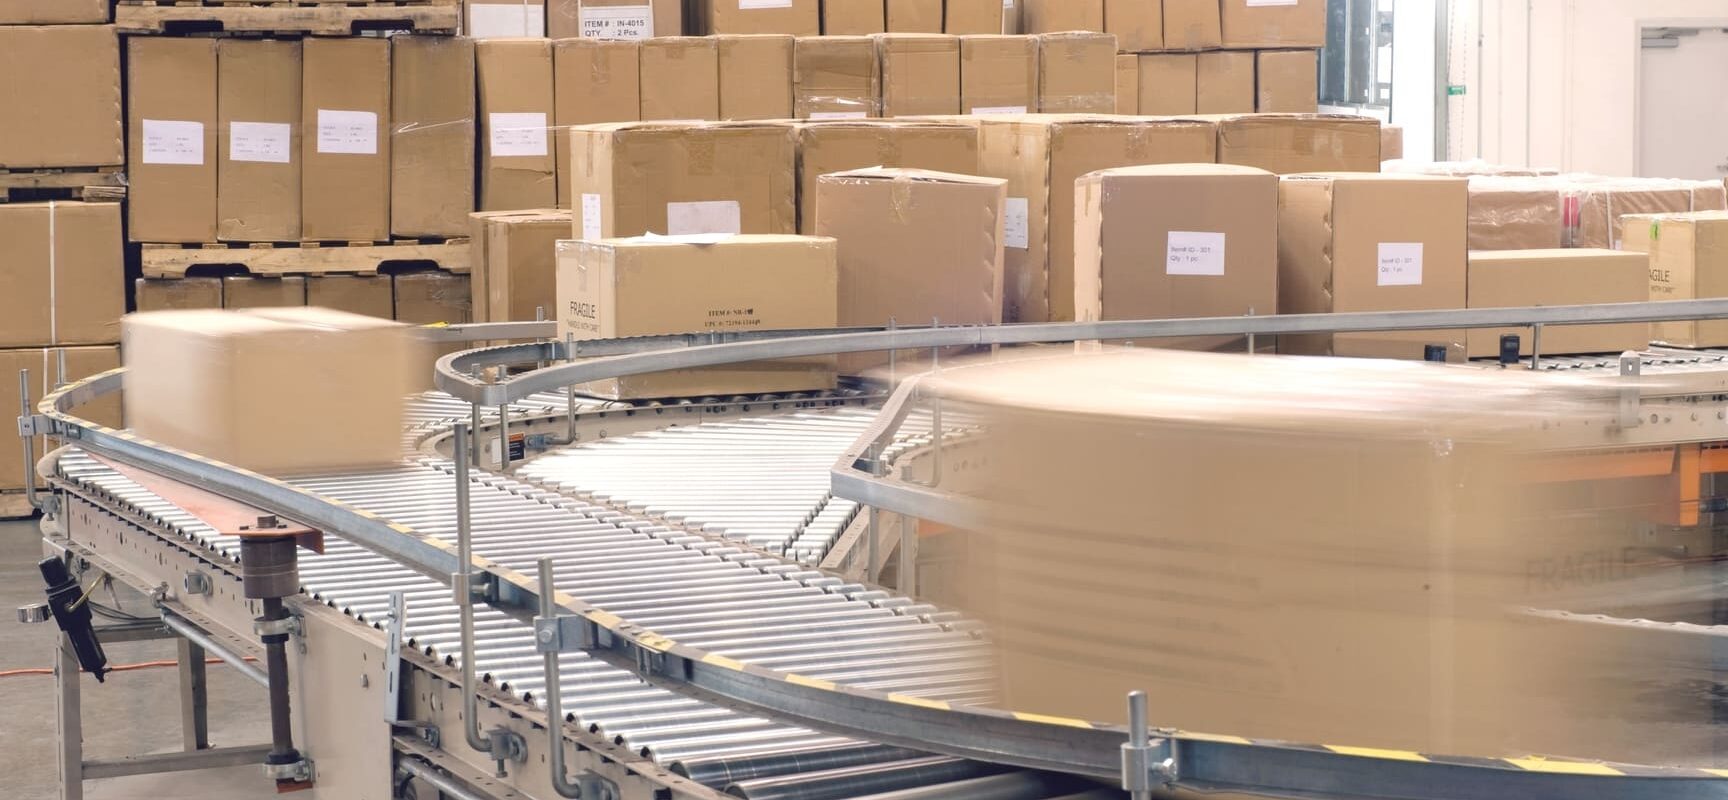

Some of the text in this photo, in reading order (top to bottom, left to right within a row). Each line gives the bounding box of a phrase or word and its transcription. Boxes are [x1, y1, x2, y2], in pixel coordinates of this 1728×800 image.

[584, 20, 603, 28] ITEM
[570, 300, 596, 319] FRAGILE
[708, 309, 725, 317] ITEM
